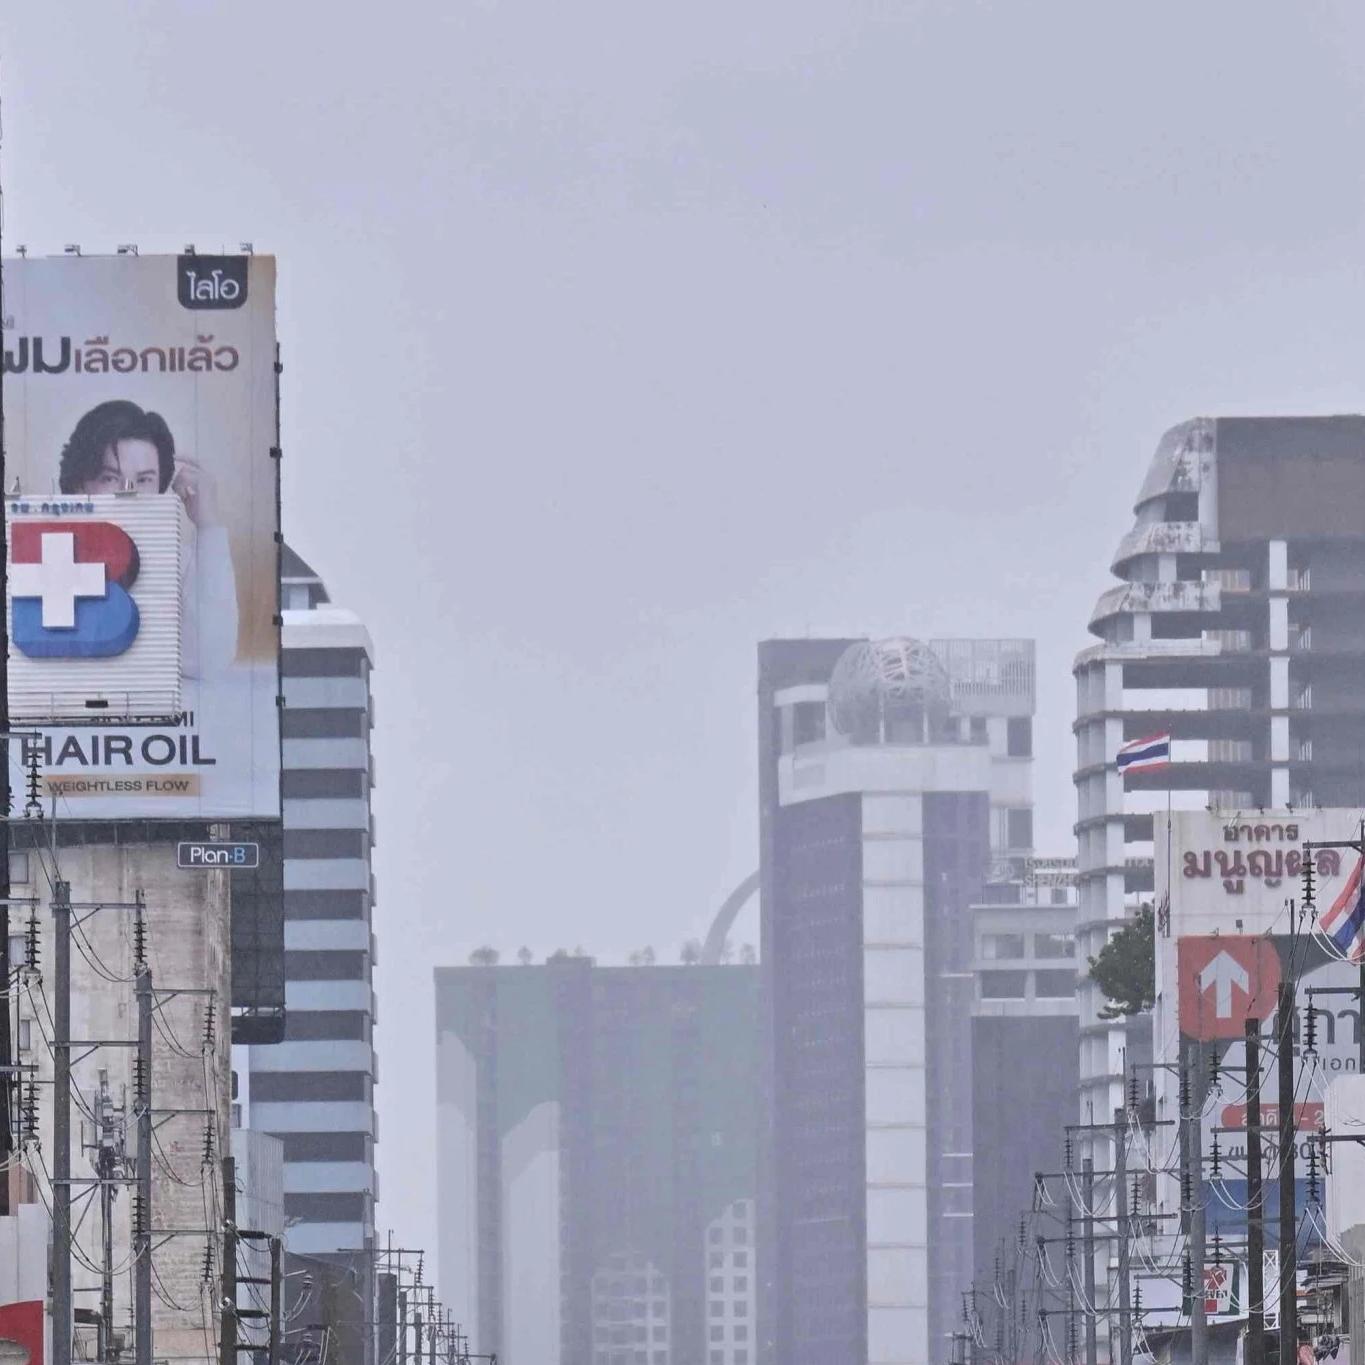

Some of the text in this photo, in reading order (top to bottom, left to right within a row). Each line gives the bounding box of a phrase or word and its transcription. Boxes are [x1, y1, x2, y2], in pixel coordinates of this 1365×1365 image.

[186, 270, 239, 300] ไลโอ
[21, 734, 216, 766] HAIR OIL
[47, 780, 189, 793] WEIGHTLESS FLOW
